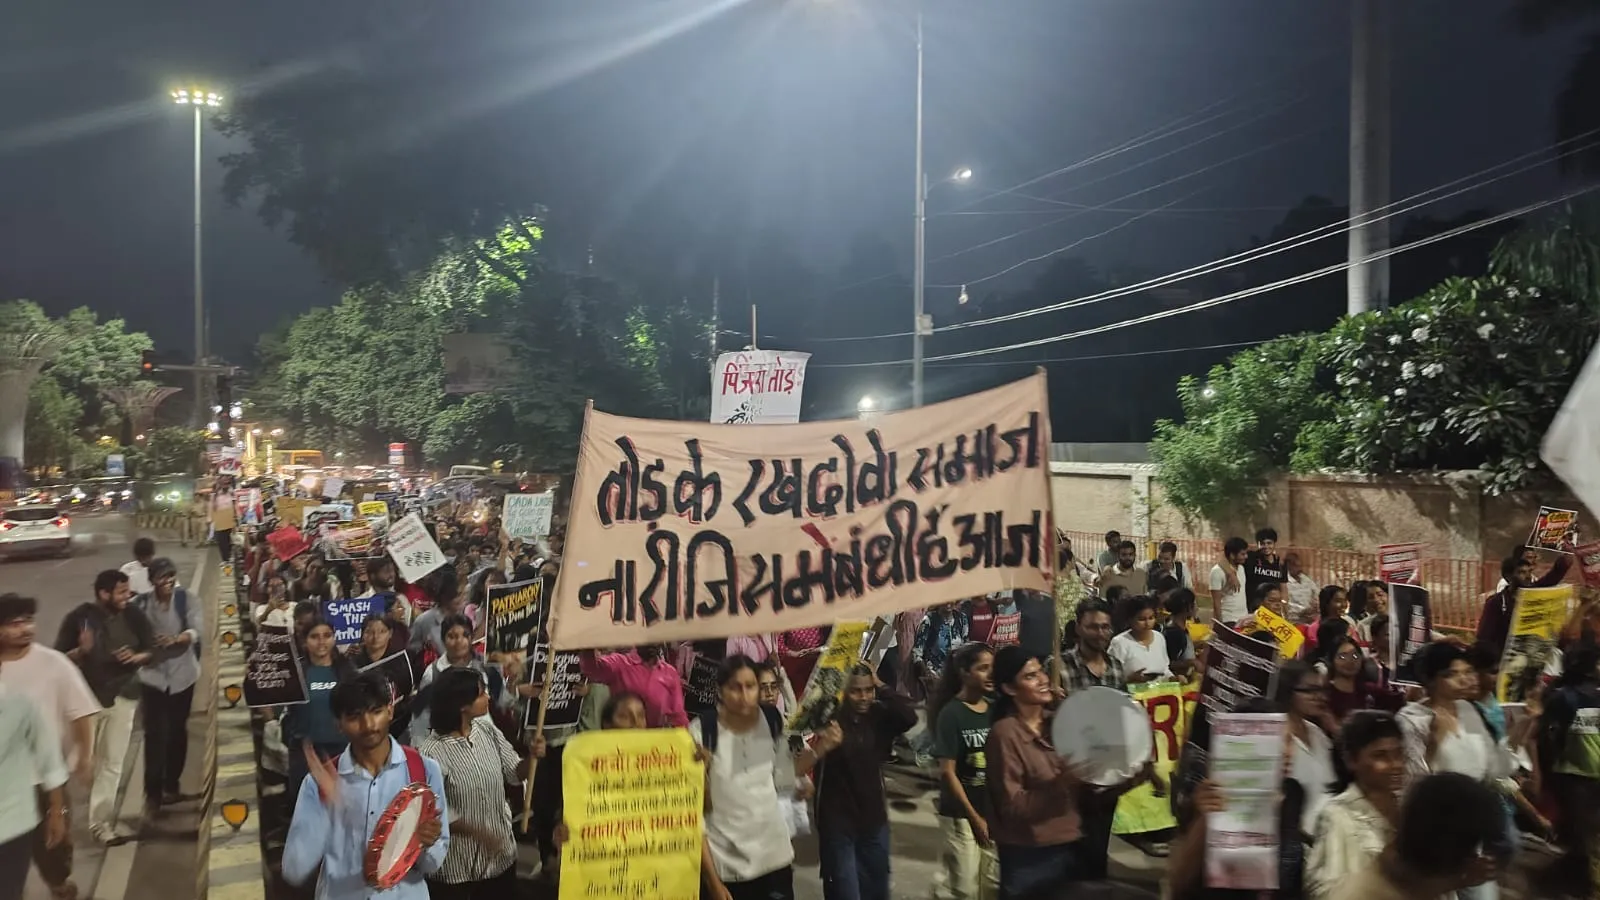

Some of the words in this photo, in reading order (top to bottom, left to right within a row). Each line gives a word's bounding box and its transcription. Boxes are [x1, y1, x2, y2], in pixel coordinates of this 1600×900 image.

[907, 411, 1041, 493] समाज
[328, 602, 371, 616] SMASH
[492, 581, 541, 616] PATRIARCHY
